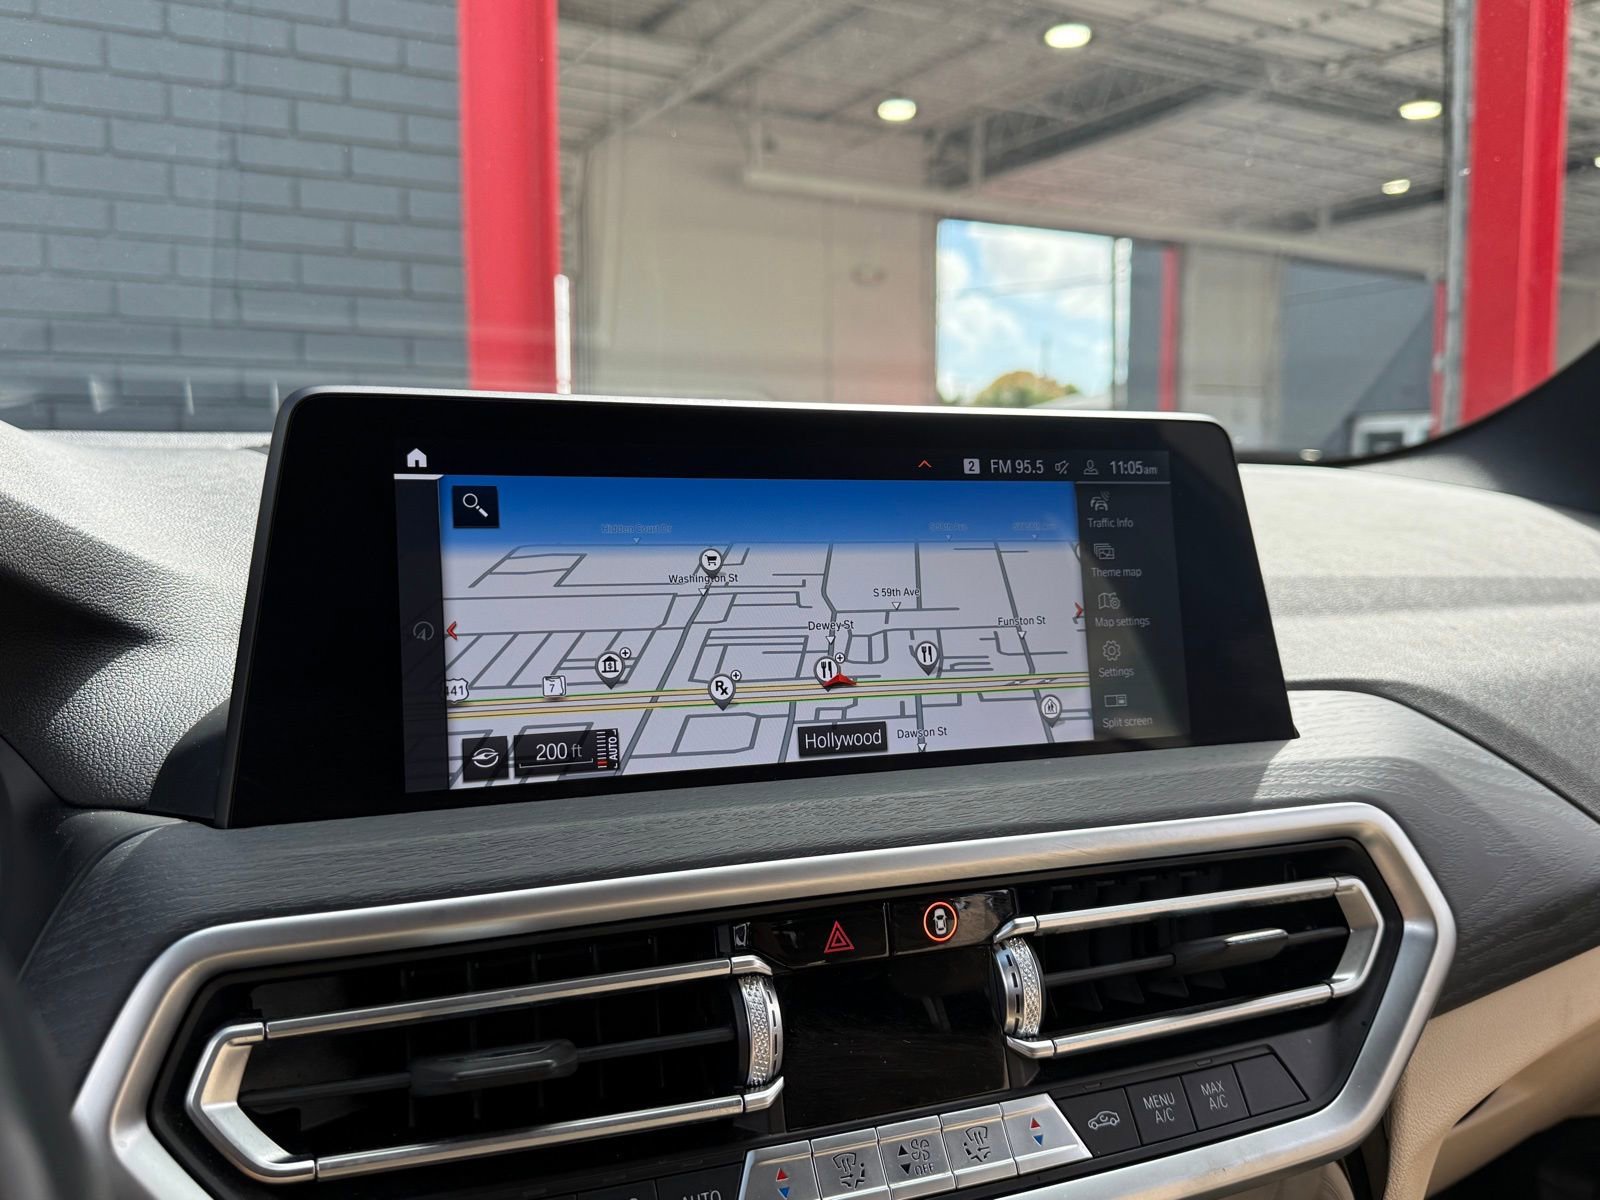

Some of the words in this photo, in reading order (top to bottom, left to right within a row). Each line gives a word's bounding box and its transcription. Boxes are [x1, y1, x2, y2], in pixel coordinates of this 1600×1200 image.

[991, 459, 1012, 474] FM
[1015, 459, 1044, 474] 95.5
[1087, 517, 1115, 528] Traffic
[1116, 517, 1134, 528] Info
[668, 574, 726, 584] Washington
[728, 573, 739, 583] St
[1090, 567, 1121, 577] Theme
[1122, 568, 1142, 578] map
[873, 588, 879, 597] S
[881, 588, 901, 597] 59th
[903, 587, 920, 597] Ave
[808, 621, 842, 632] Dewey
[843, 619, 855, 630] St
[997, 617, 1035, 626] Funston
[1036, 615, 1046, 625] St
[1095, 617, 1115, 628] Map
[1115, 616, 1151, 628] settings
[1098, 666, 1135, 678] Settings
[549, 683, 555, 693] 7
[1102, 717, 1122, 729] Split
[1124, 716, 1153, 727] screen
[897, 728, 935, 739] Dawson
[937, 726, 948, 736] St
[805, 729, 882, 750] Hollywood
[536, 742, 568, 761] 200
[571, 743, 583, 758] ft
[608, 736, 618, 761] AUTO
[1200, 1080, 1225, 1096] MAX
[1143, 1092, 1175, 1110] MENU
[1208, 1094, 1229, 1112] A/C
[1155, 1107, 1175, 1124] A/C
[914, 1162, 934, 1175] OFF
[682, 1190, 722, 1200] TO
